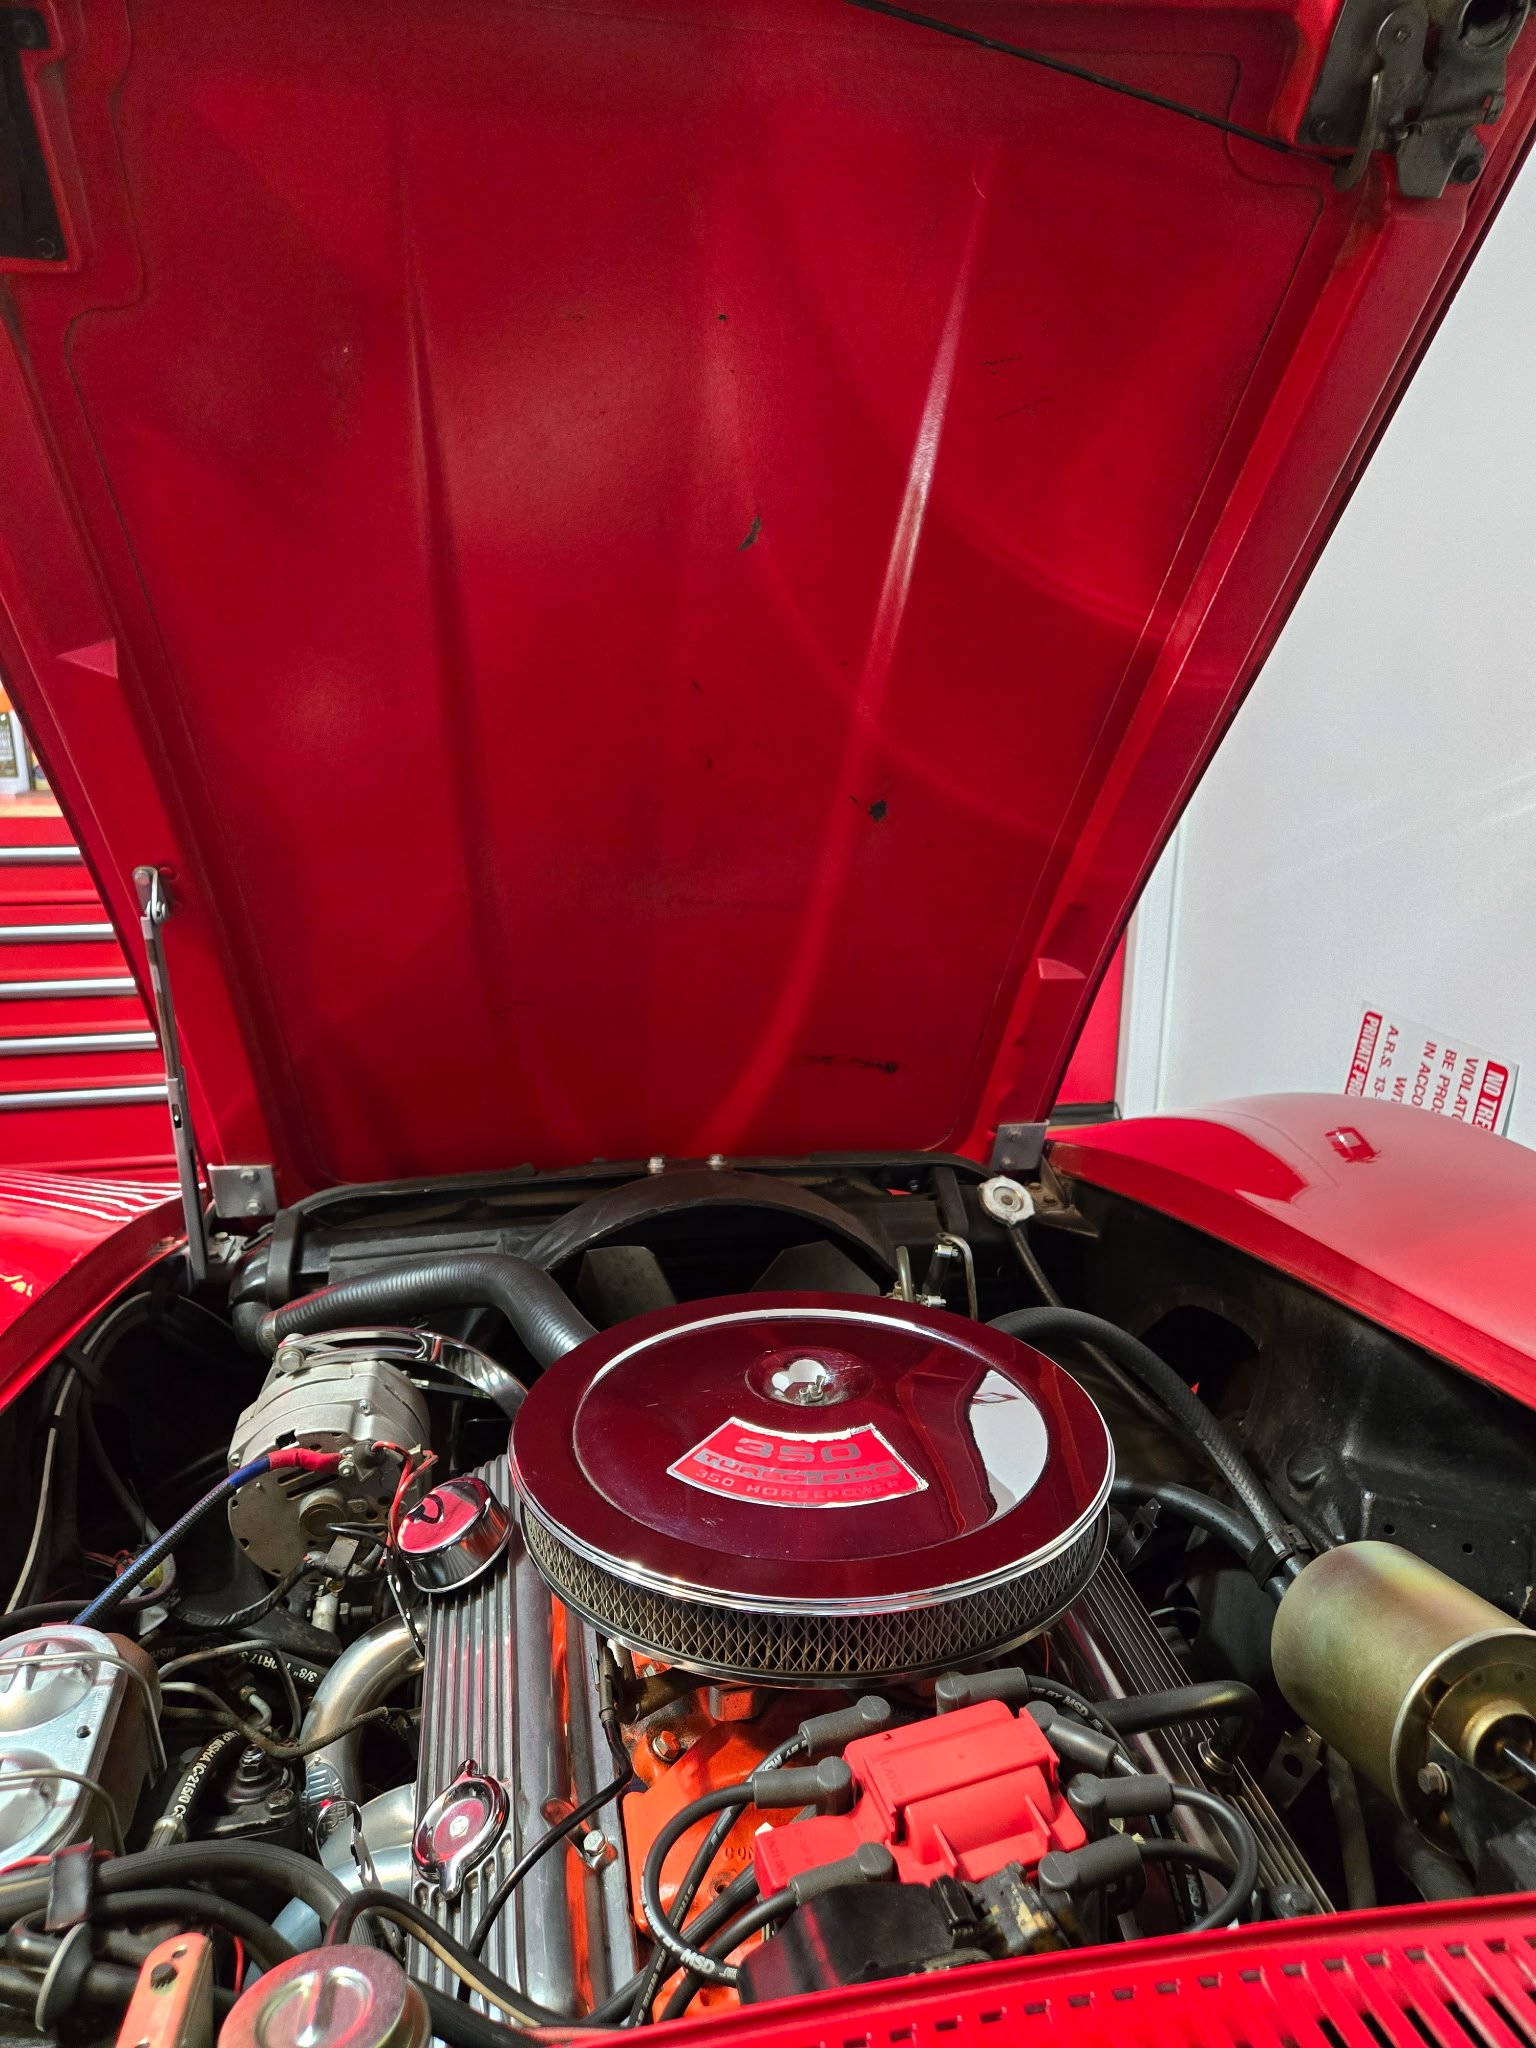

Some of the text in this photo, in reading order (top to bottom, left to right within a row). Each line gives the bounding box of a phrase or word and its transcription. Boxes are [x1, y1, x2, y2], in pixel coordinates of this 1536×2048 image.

[1352, 1015, 1381, 1075] PRIVATE
[1423, 1041, 1437, 1060] IN
[1441, 1048, 1457, 1072] BE
[1374, 1075, 1386, 1098] 13-
[1481, 1067, 1506, 1098] NO
[734, 1437, 862, 1463] 350
[695, 1468, 898, 1498] 350 HORSEPOWER
[200, 1738, 225, 1762] MSHA
[1184, 1872, 1203, 1908] MSD
[680, 1948, 716, 1975] MSD
